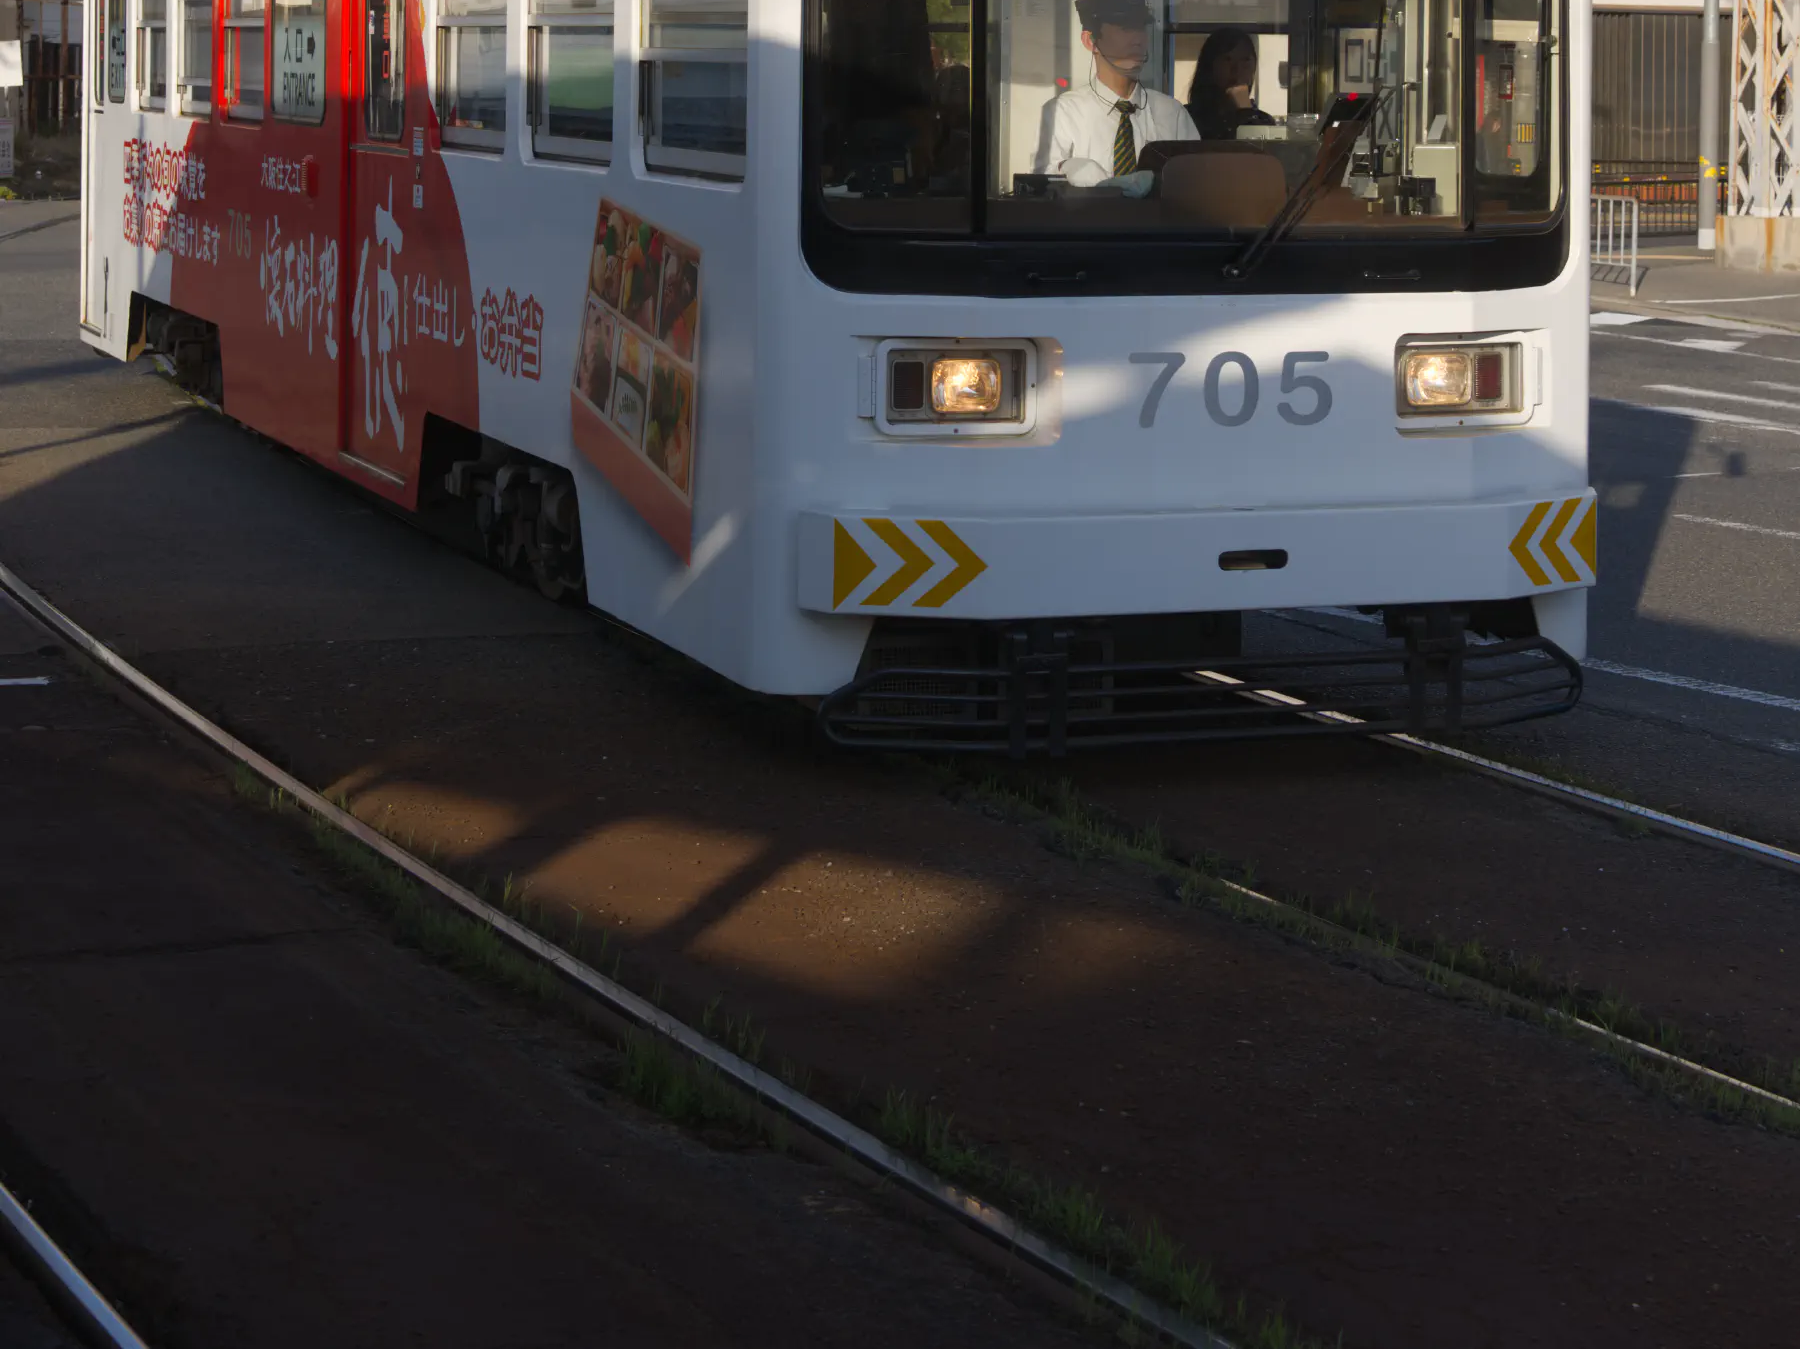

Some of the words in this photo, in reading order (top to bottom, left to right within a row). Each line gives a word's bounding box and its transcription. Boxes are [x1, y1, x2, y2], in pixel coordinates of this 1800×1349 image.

[284, 28, 303, 63] 入口
[284, 73, 315, 107] ENTRANCE
[261, 153, 301, 193] 大阪住之江
[227, 208, 251, 259] 705
[260, 215, 338, 360] 懐石料理
[1129, 351, 1332, 428] 705
